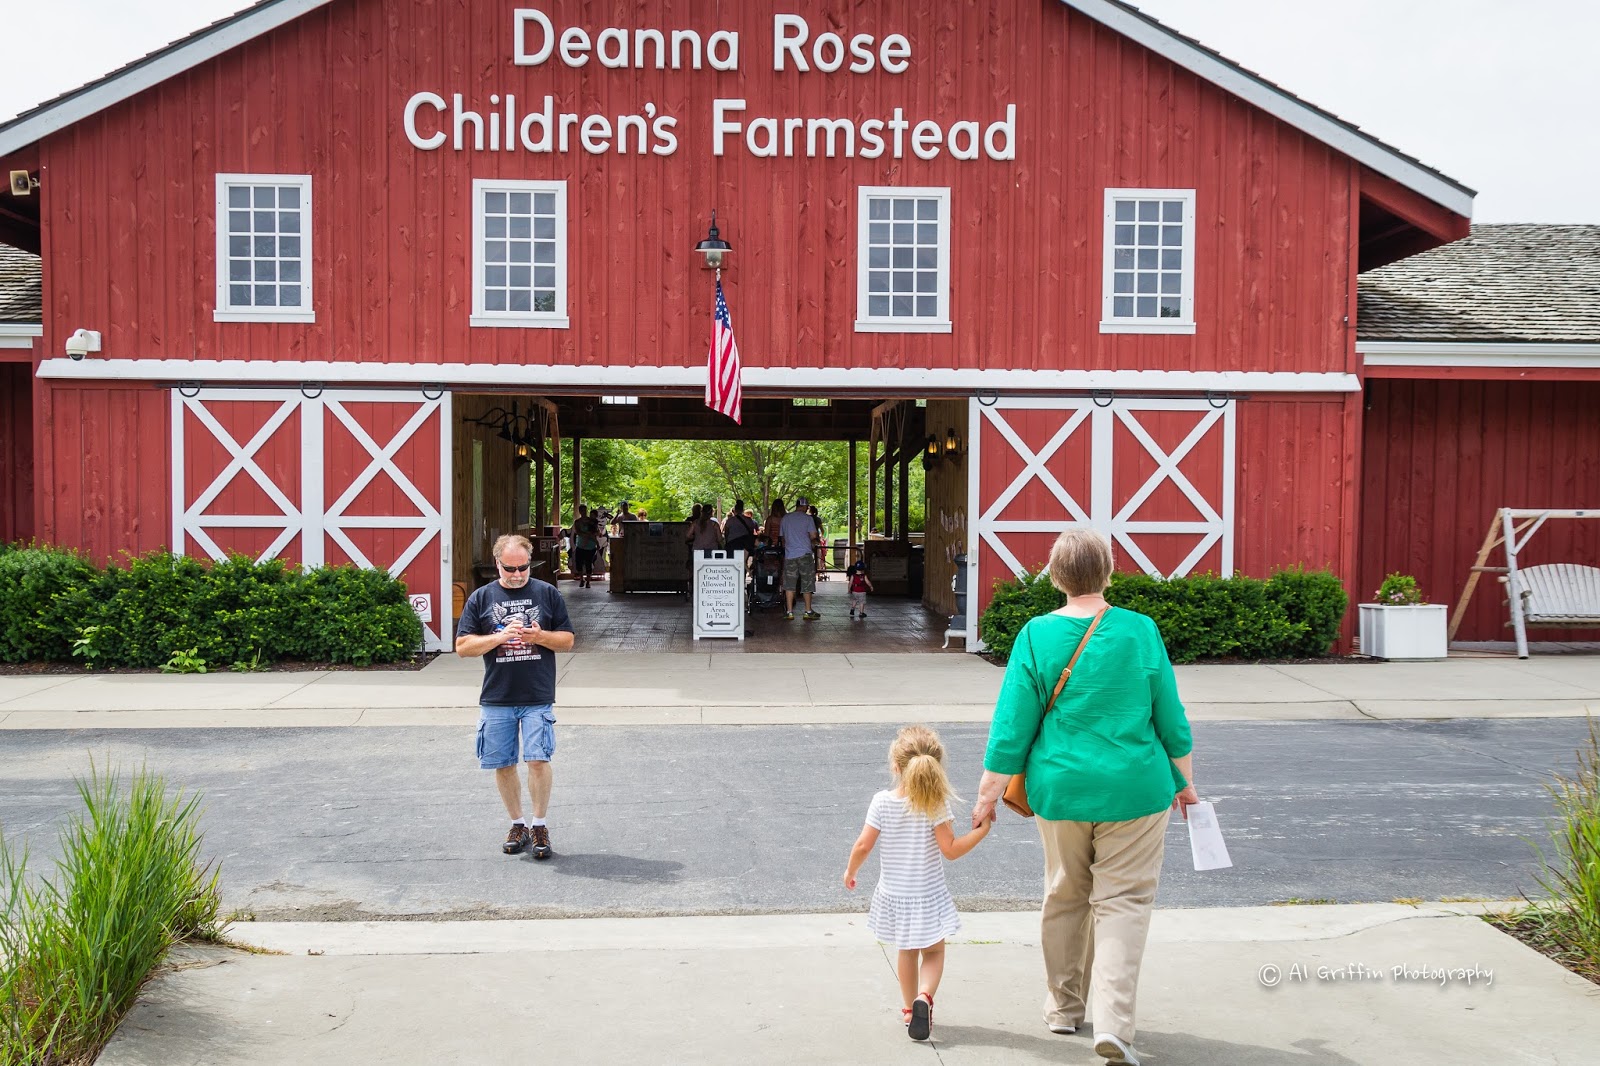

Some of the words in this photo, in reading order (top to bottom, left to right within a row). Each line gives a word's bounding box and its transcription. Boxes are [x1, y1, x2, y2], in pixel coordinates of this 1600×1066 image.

[513, 7, 740, 72] Deanna
[773, 13, 912, 75] Rose
[403, 91, 680, 157] Children's
[712, 98, 1018, 162] Farmstead
